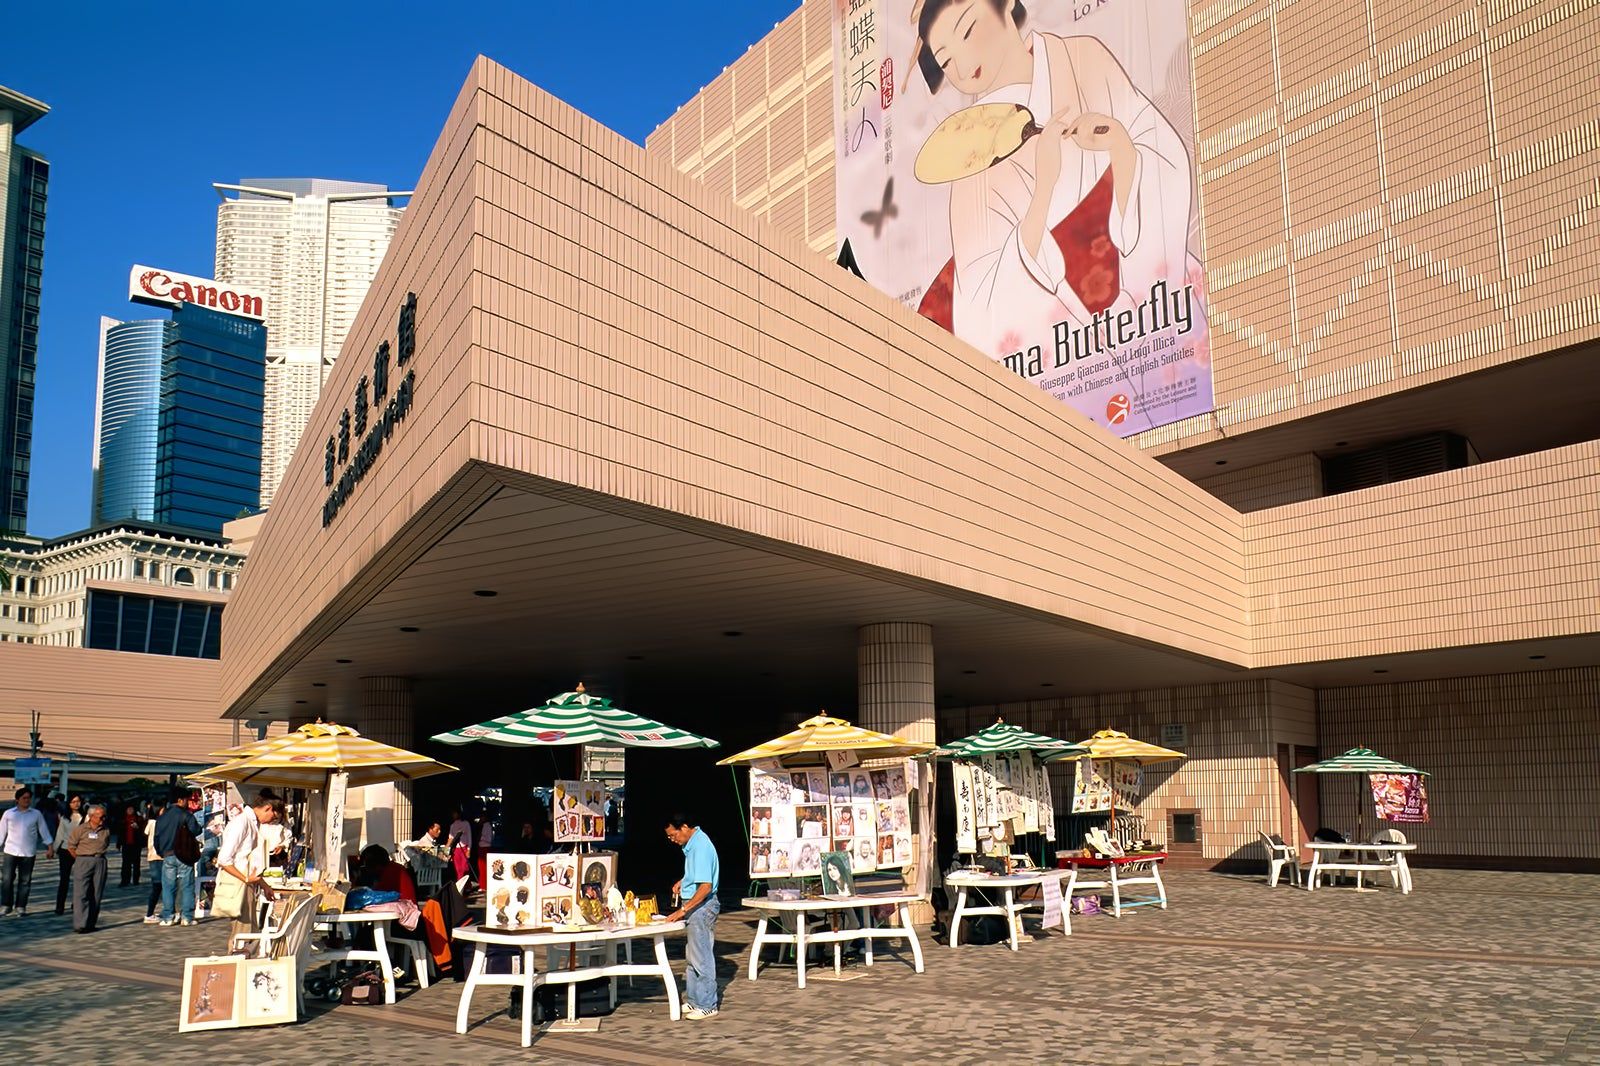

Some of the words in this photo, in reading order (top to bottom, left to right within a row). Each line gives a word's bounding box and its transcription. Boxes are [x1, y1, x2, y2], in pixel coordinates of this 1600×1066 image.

[1073, 3, 1091, 21] LO
[140, 271, 263, 317] Canon
[1002, 345, 1044, 379] ma
[1052, 280, 1192, 370] Butterfly
[1067, 385, 1083, 398] with
[1084, 375, 1113, 393] Chinese
[1115, 368, 1129, 382] and
[1131, 355, 1159, 377] English
[1161, 346, 1195, 366] Surtitles
[1077, 360, 1109, 380] Giacosa
[1112, 350, 1127, 366] and
[1129, 341, 1151, 361] Luigi
[1153, 336, 1176, 352] Illica
